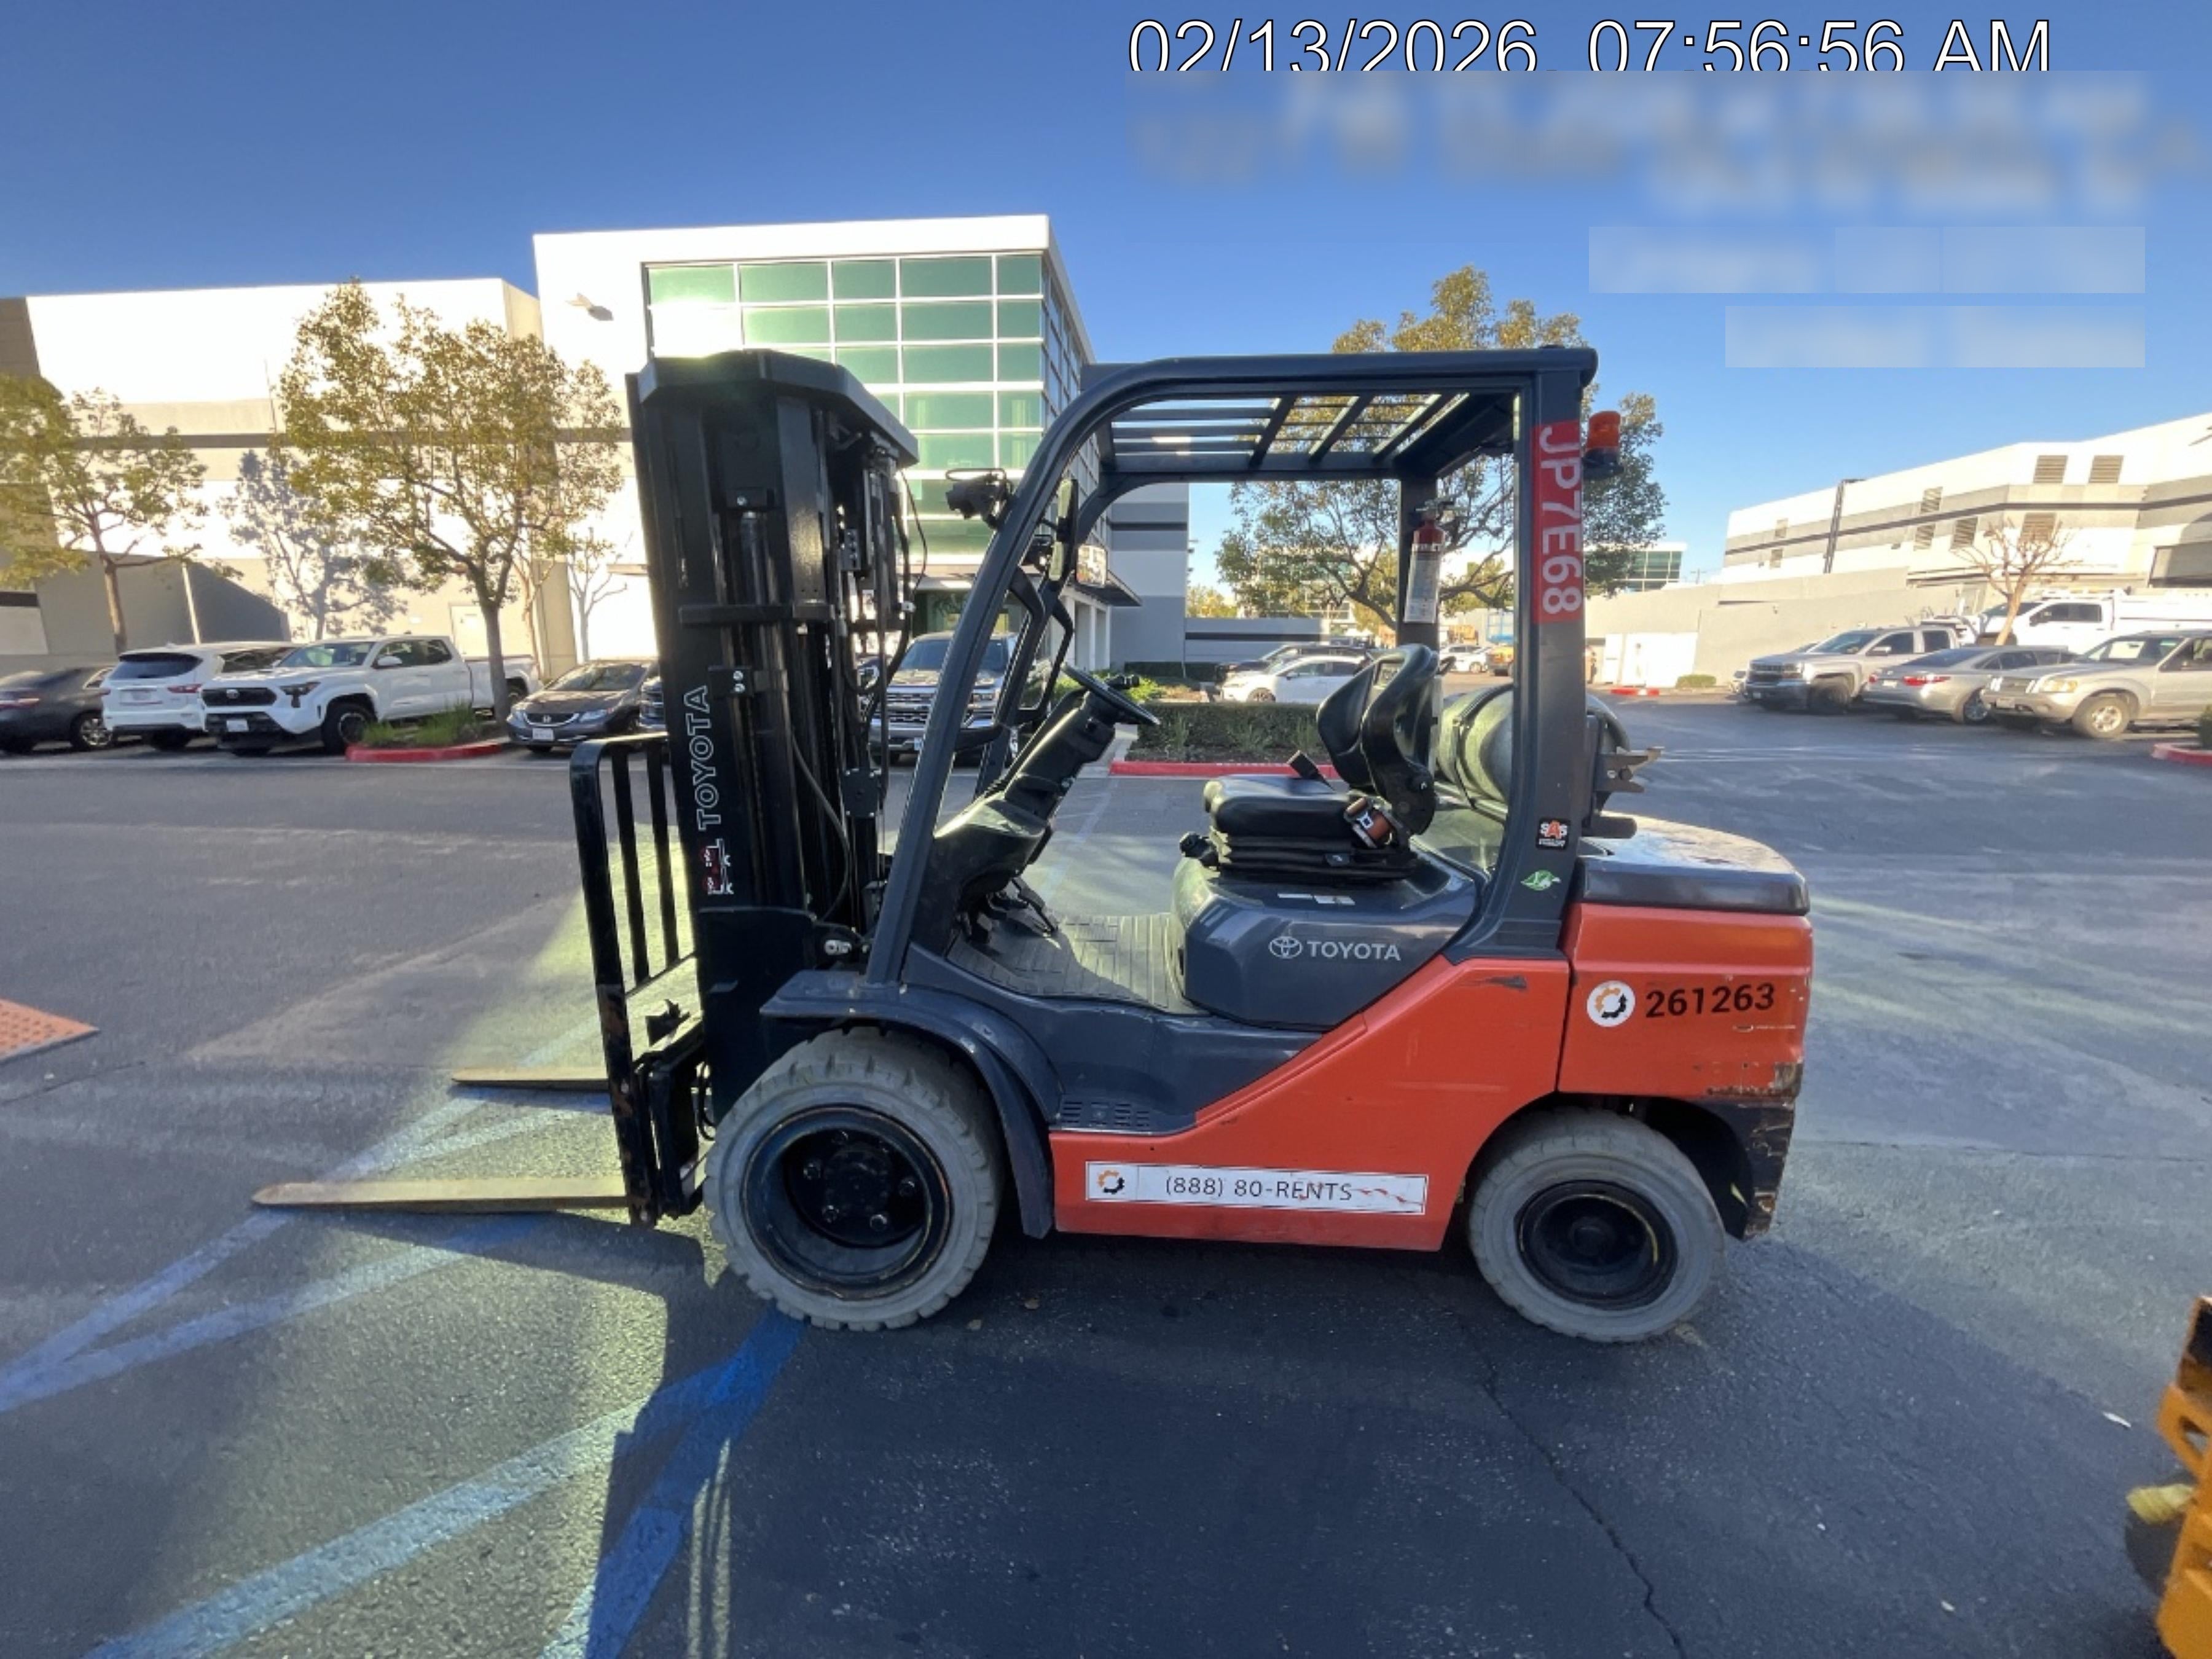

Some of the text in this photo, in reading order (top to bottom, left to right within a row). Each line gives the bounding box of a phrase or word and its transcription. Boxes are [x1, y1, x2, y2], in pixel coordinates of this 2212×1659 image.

[1539, 426, 1583, 614] JP7E68
[683, 684, 721, 832] TOYOTA
[1306, 940, 1402, 961] TOYOTA
[1645, 982, 1776, 1019] 261263
[1166, 1176, 1352, 1201] (888) 80-RENTS
